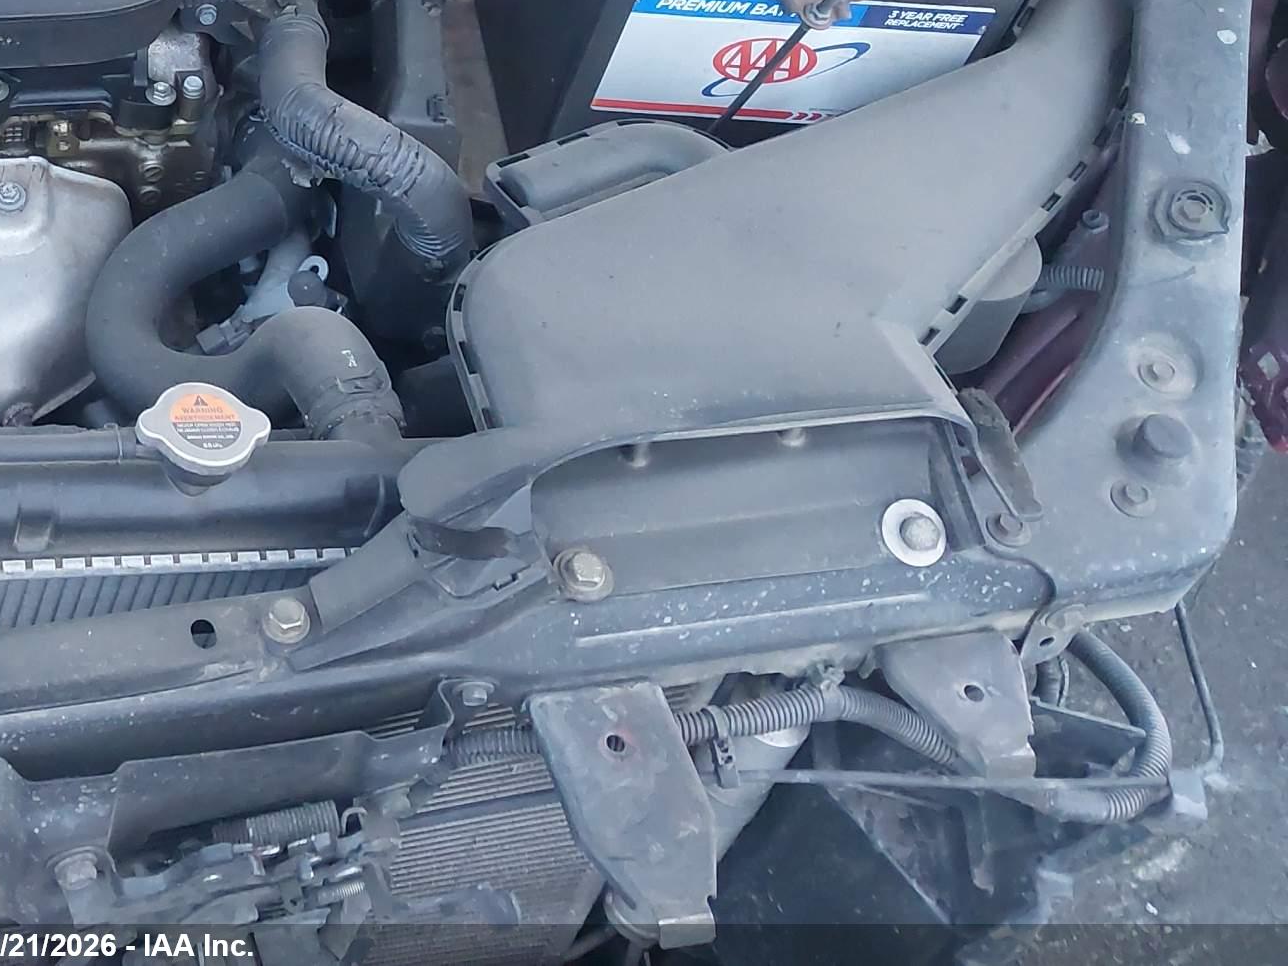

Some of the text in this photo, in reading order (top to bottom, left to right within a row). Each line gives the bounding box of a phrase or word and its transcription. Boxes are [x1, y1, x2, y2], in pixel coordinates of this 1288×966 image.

[888, 10, 969, 23] 3 YEAR FREE
[713, 37, 818, 84] AAA
